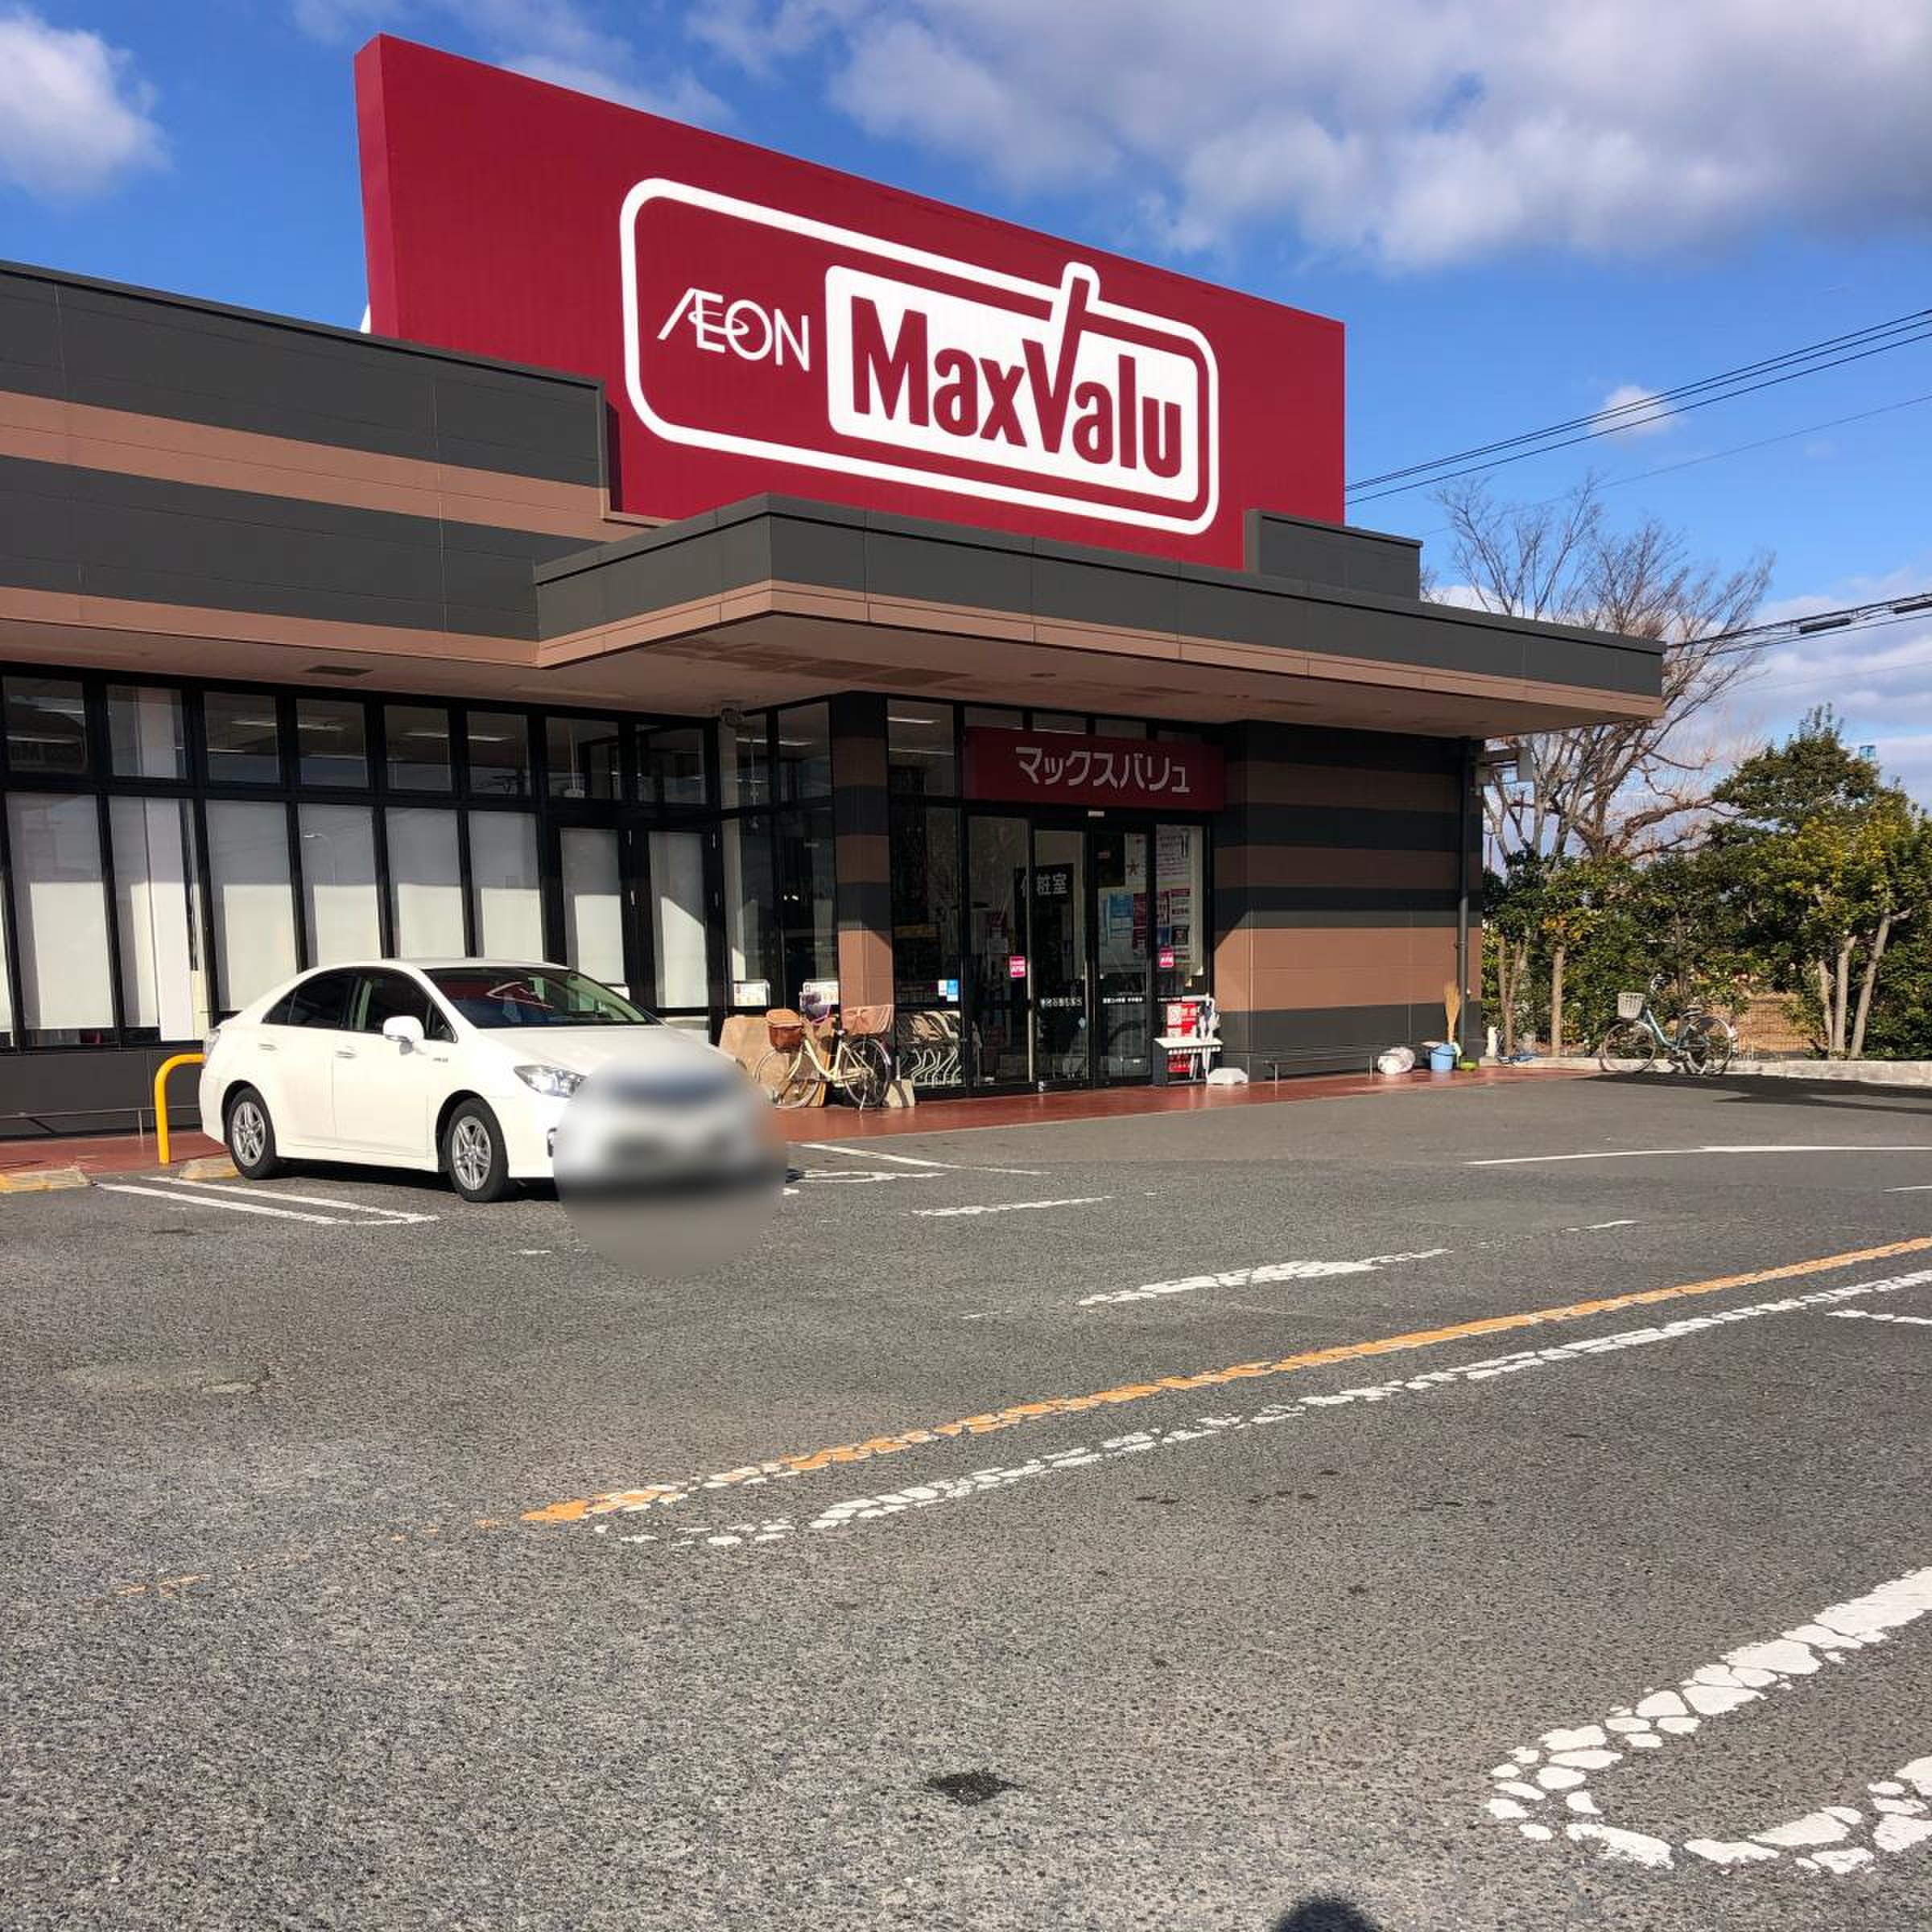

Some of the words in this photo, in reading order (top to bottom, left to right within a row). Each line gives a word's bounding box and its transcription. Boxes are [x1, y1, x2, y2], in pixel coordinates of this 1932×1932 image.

[851, 277, 1182, 478] MaxValu
[1015, 746, 1190, 793] マックスバリュ
